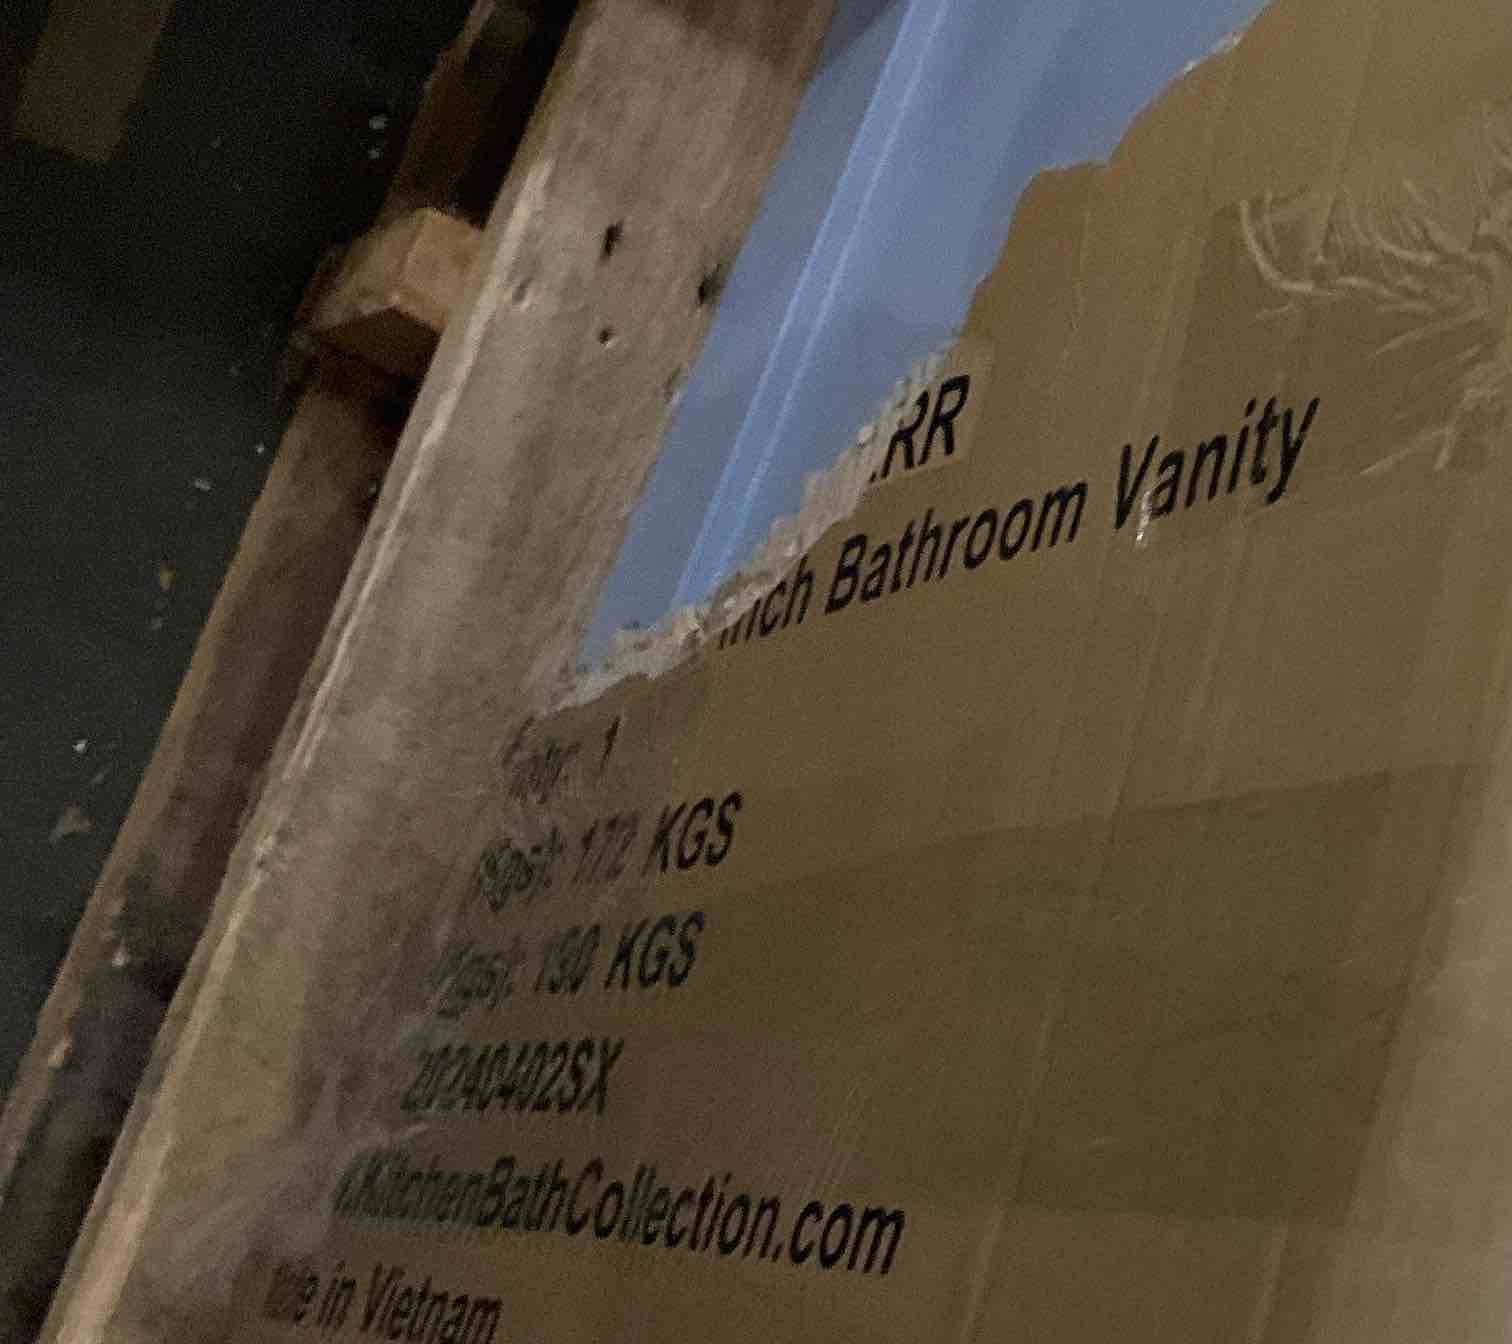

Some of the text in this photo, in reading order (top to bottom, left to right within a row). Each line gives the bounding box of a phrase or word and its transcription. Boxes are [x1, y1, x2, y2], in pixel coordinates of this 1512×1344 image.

[869, 373, 972, 484] RR
[824, 479, 1087, 616] Bathroom
[1115, 397, 1321, 531] Vanity
[641, 790, 744, 876] KGS
[603, 909, 706, 993] KGS
